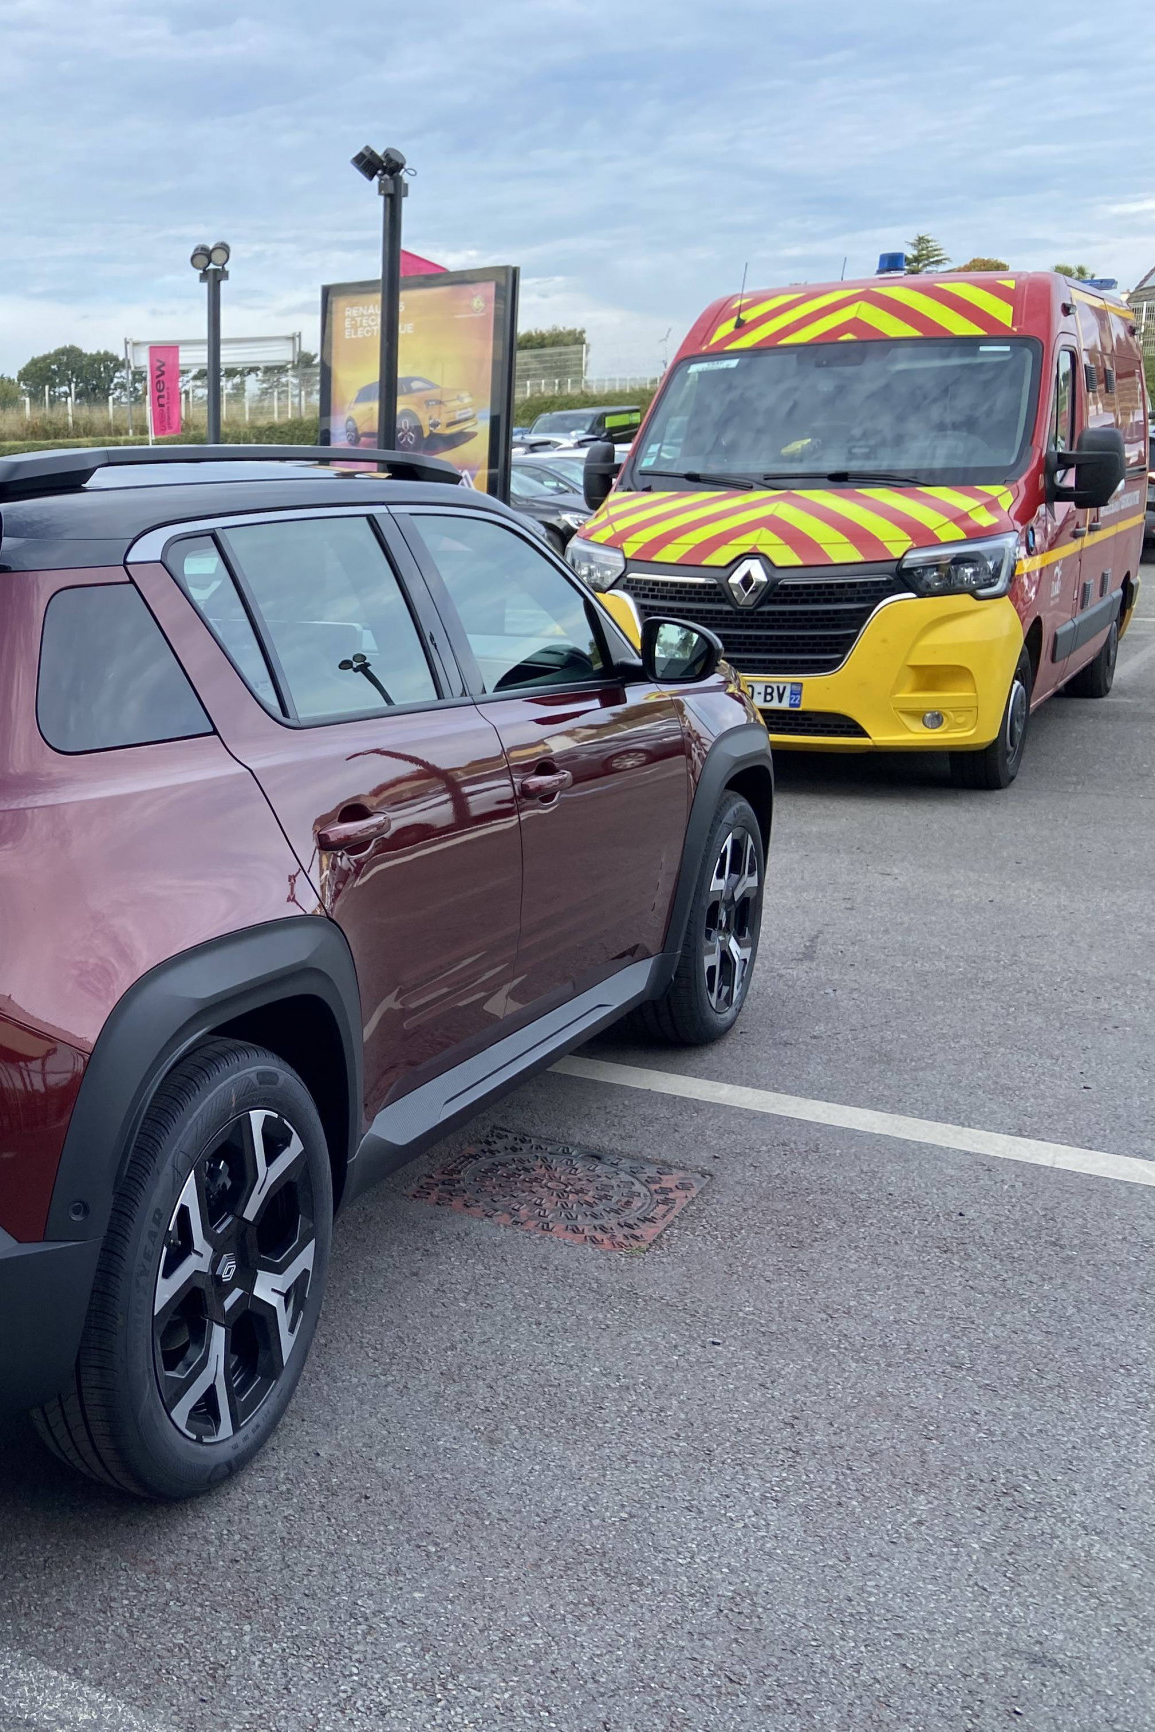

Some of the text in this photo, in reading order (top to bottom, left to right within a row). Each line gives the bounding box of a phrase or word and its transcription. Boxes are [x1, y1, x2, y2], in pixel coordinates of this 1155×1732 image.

[345, 303, 381, 317] RENAU
[345, 323, 414, 339] ELECTUE
[155, 358, 166, 431] new
[790, 694, 801, 704] 22
